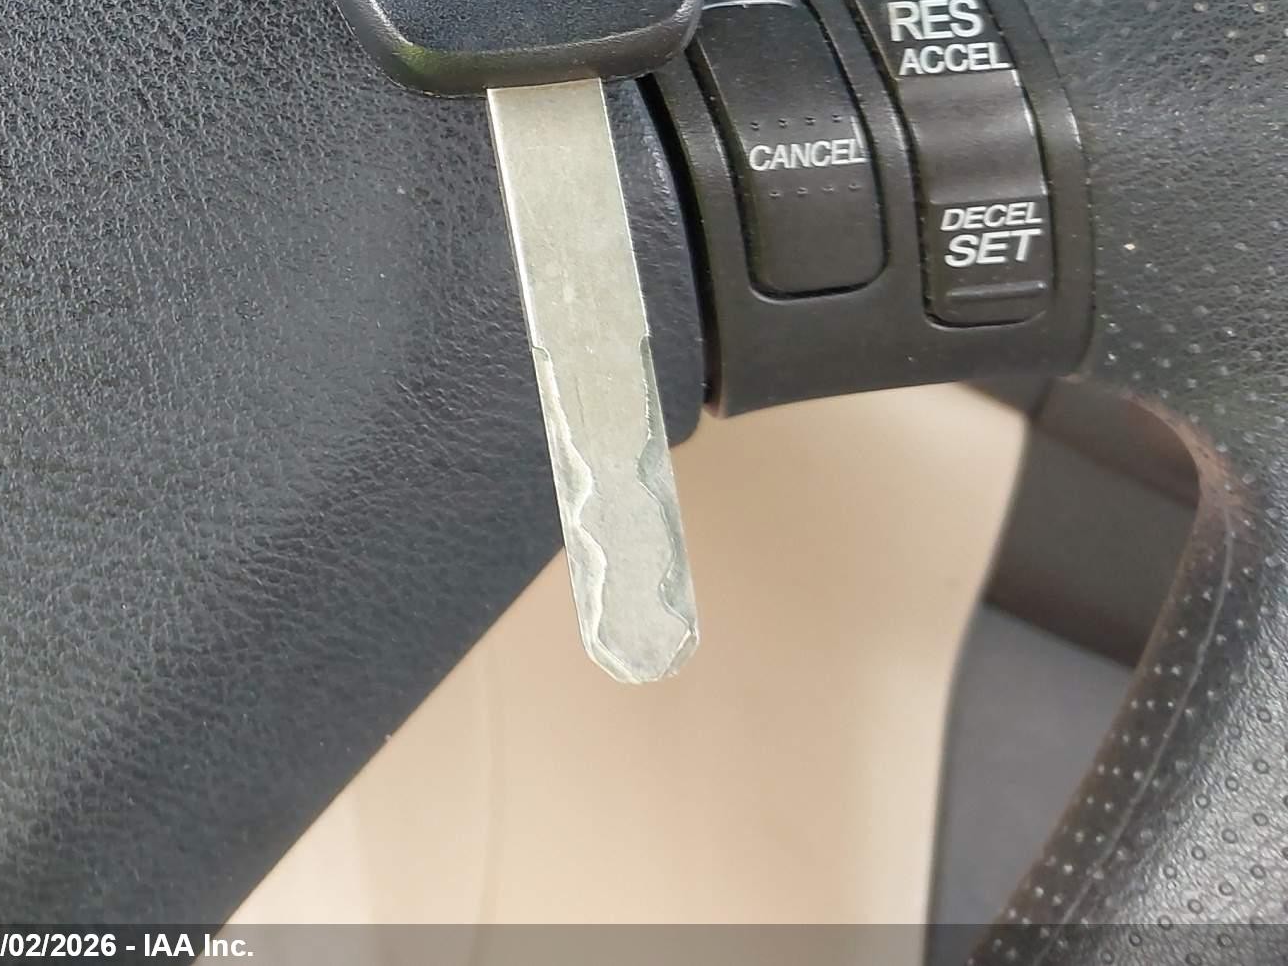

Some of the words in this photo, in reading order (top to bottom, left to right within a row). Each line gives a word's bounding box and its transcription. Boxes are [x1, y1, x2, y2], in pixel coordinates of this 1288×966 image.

[899, 43, 1011, 76] ACCEL
[748, 137, 867, 172] CANCEL
[940, 200, 1043, 232] DECEL
[943, 229, 1042, 268] SET
